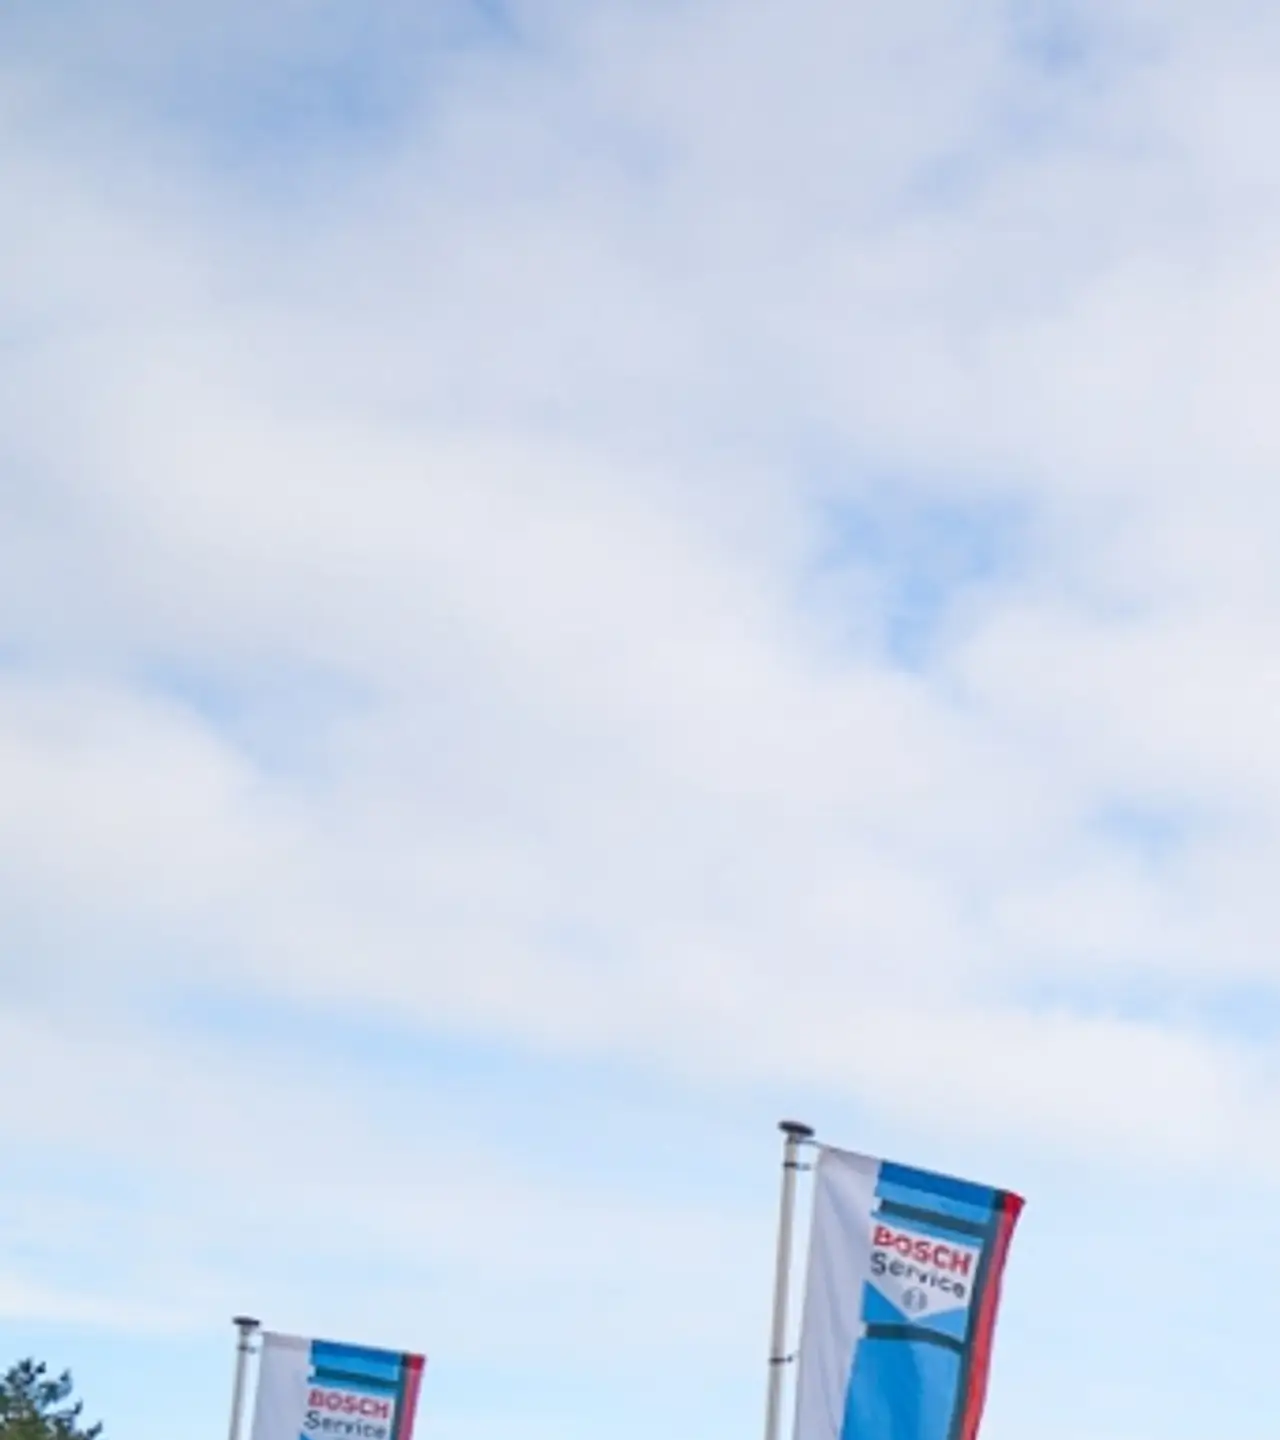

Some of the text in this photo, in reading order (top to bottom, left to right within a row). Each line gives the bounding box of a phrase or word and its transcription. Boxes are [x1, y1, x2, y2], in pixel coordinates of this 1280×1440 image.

[873, 1223, 974, 1277] BOSCH
[869, 1250, 967, 1300] Service
[307, 1387, 389, 1419] BOSCH
[303, 1408, 388, 1440] Service
